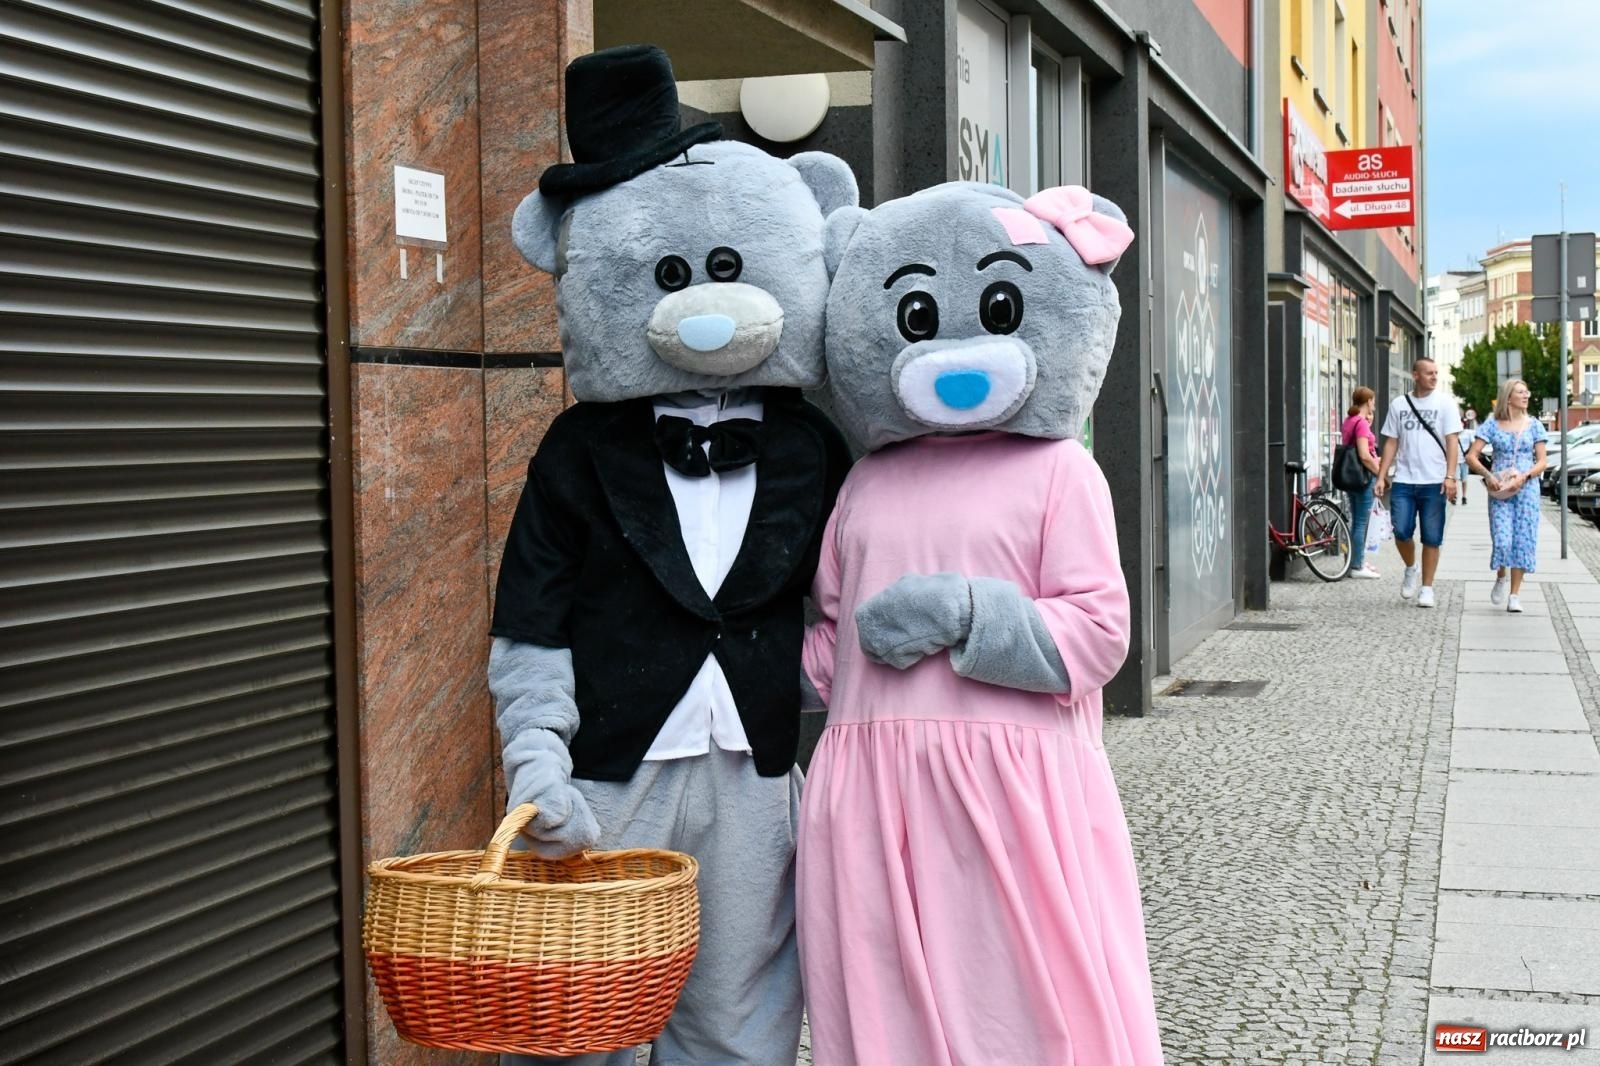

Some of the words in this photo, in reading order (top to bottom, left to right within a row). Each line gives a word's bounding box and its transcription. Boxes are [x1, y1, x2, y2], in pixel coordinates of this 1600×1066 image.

[1357, 154, 1383, 171] as
[1335, 182, 1373, 194] badanie
[1376, 181, 1408, 192] słuchu
[1350, 203, 1361, 213] ul.
[1364, 201, 1393, 213] Długa
[1395, 200, 1407, 209] 48
